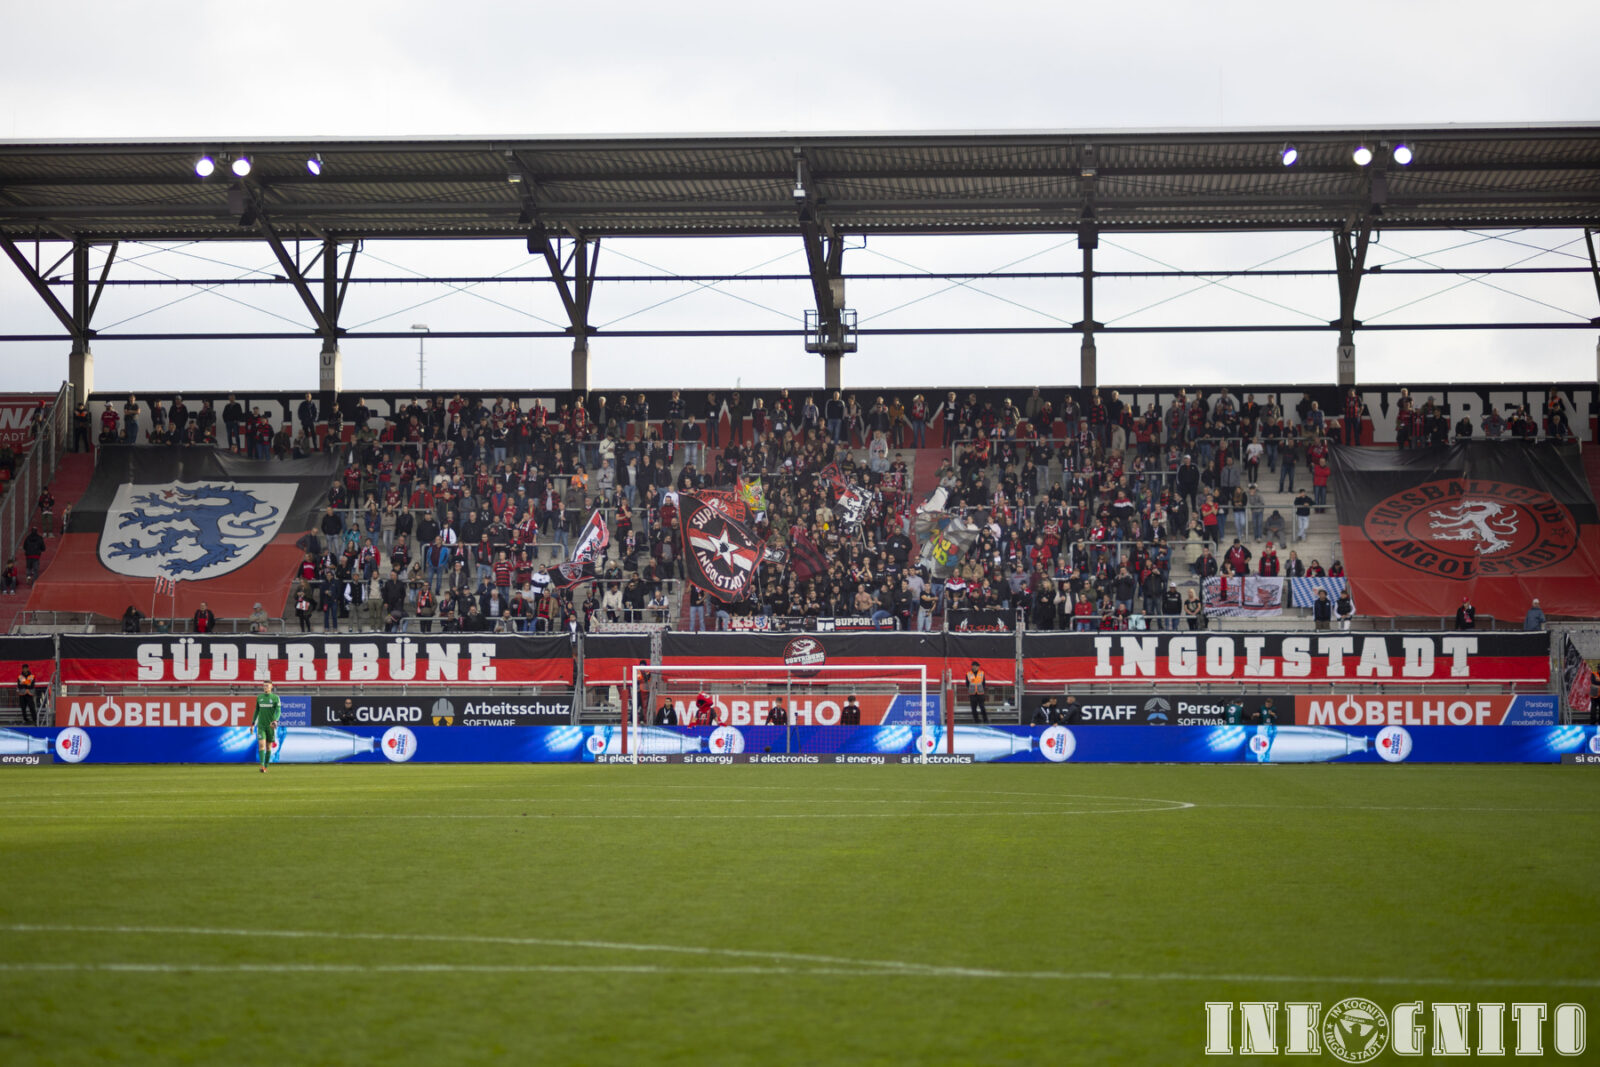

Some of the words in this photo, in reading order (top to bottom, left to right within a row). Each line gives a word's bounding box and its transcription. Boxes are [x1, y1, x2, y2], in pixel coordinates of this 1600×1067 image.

[323, 356, 331, 366] U
[1382, 537, 1567, 577] INGOLSTADT
[697, 550, 747, 590] INGOLSTADT
[136, 638, 496, 680] SÜDTRIBÜNE
[1094, 637, 1478, 677] INGOLSTADT
[68, 696, 246, 726] MÖBELHOF
[464, 702, 570, 715] Arbeitsschutz
[1307, 695, 1492, 725] MÖBELHOF
[2, 756, 40, 765] energy
[598, 754, 607, 763] si
[684, 755, 693, 763] si
[696, 756, 733, 764] energy
[750, 755, 759, 763] si
[761, 755, 819, 763] electronics
[835, 755, 844, 763] si
[847, 756, 885, 764] energy
[902, 755, 911, 763] si
[1576, 754, 1585, 762] si
